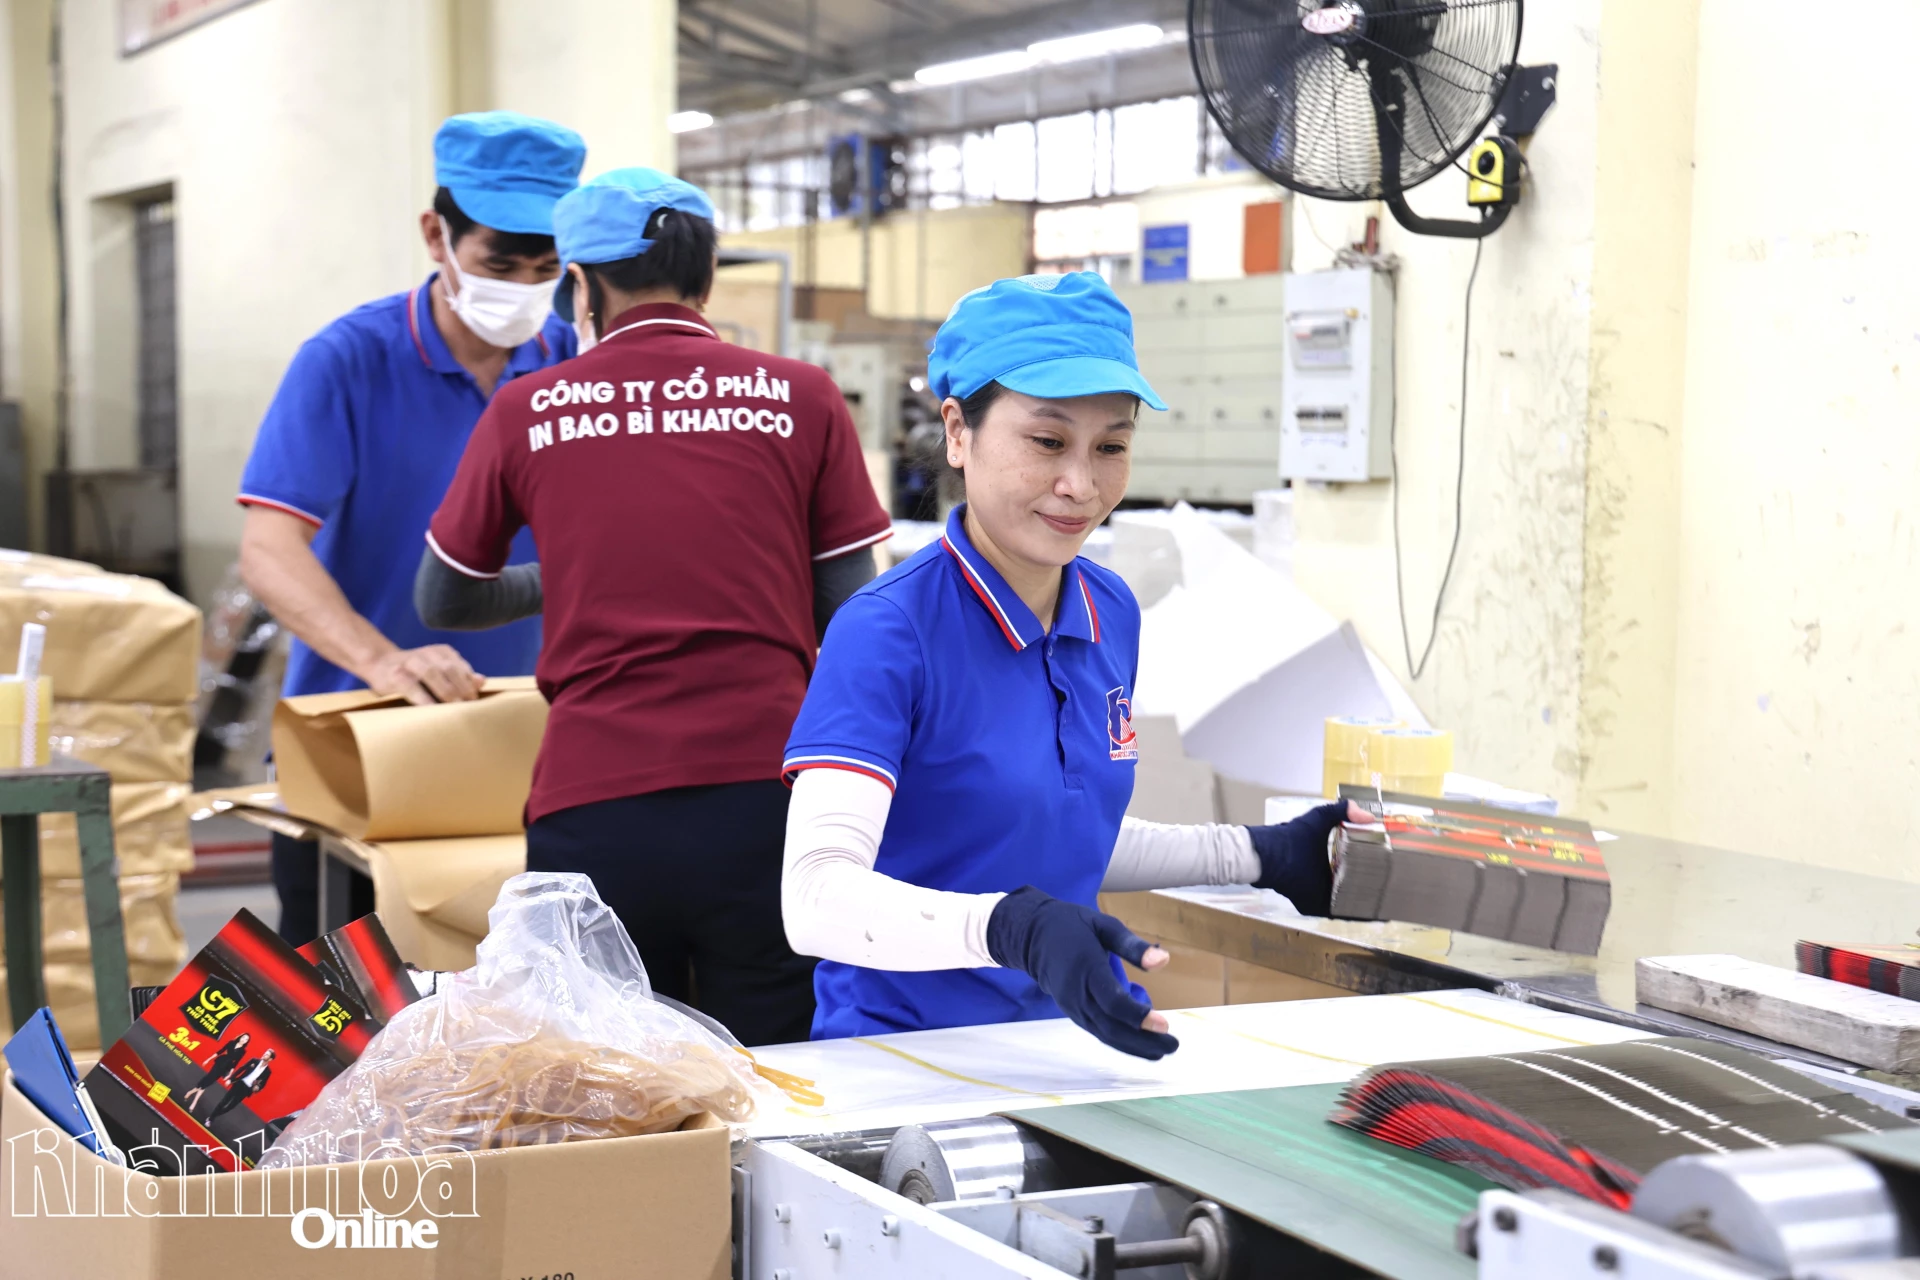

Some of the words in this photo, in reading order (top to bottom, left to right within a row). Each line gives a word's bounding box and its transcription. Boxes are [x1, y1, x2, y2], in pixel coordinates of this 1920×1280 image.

[530, 379, 616, 412] CÔNG
[622, 380, 655, 402] TY
[662, 366, 709, 401] CỔ
[715, 366, 790, 403] PHẦN
[528, 421, 553, 452] IN
[558, 412, 619, 442] BAO
[626, 405, 654, 434] BÌ
[662, 407, 794, 438] KHATOCO
[168, 1026, 201, 1051] 3in1
